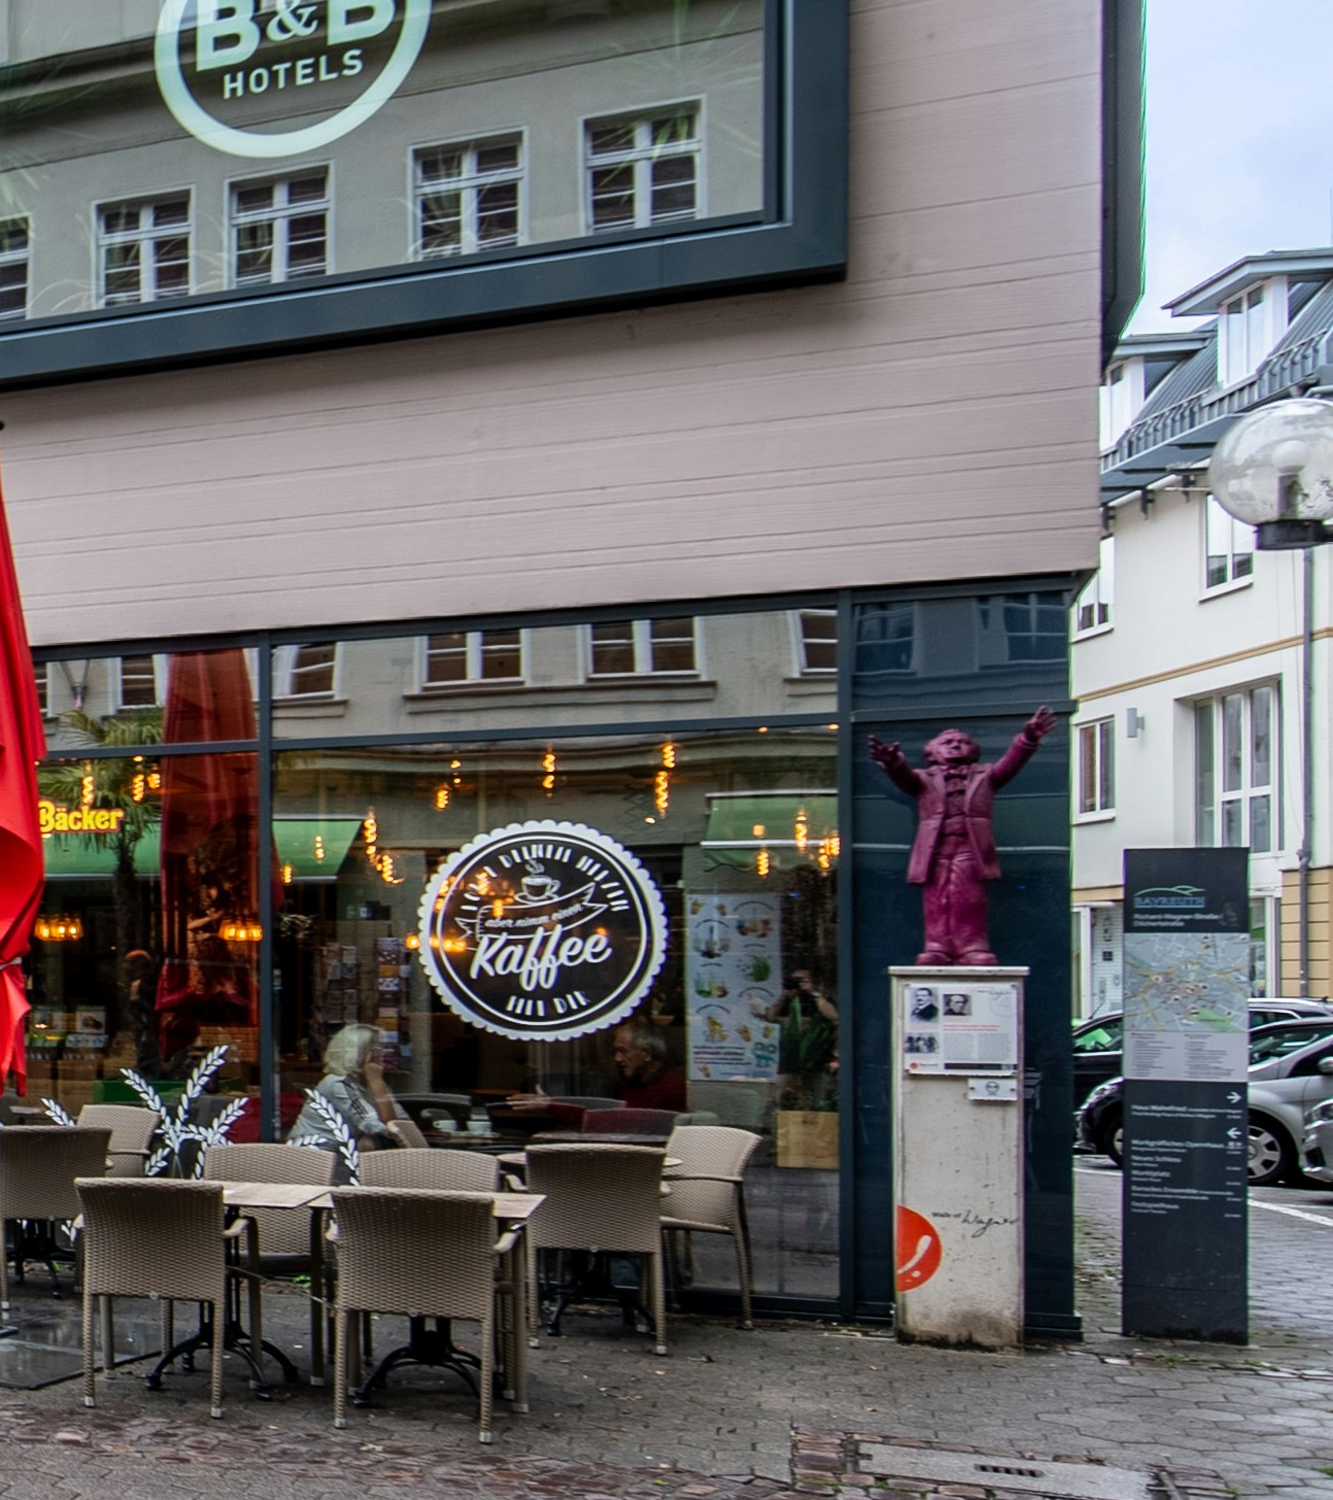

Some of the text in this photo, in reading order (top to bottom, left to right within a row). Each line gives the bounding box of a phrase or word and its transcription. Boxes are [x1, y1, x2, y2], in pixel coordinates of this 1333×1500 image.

[223, 48, 363, 100] HOTELS
[38, 800, 124, 833] Bäcker
[469, 924, 613, 991] Kaffee
